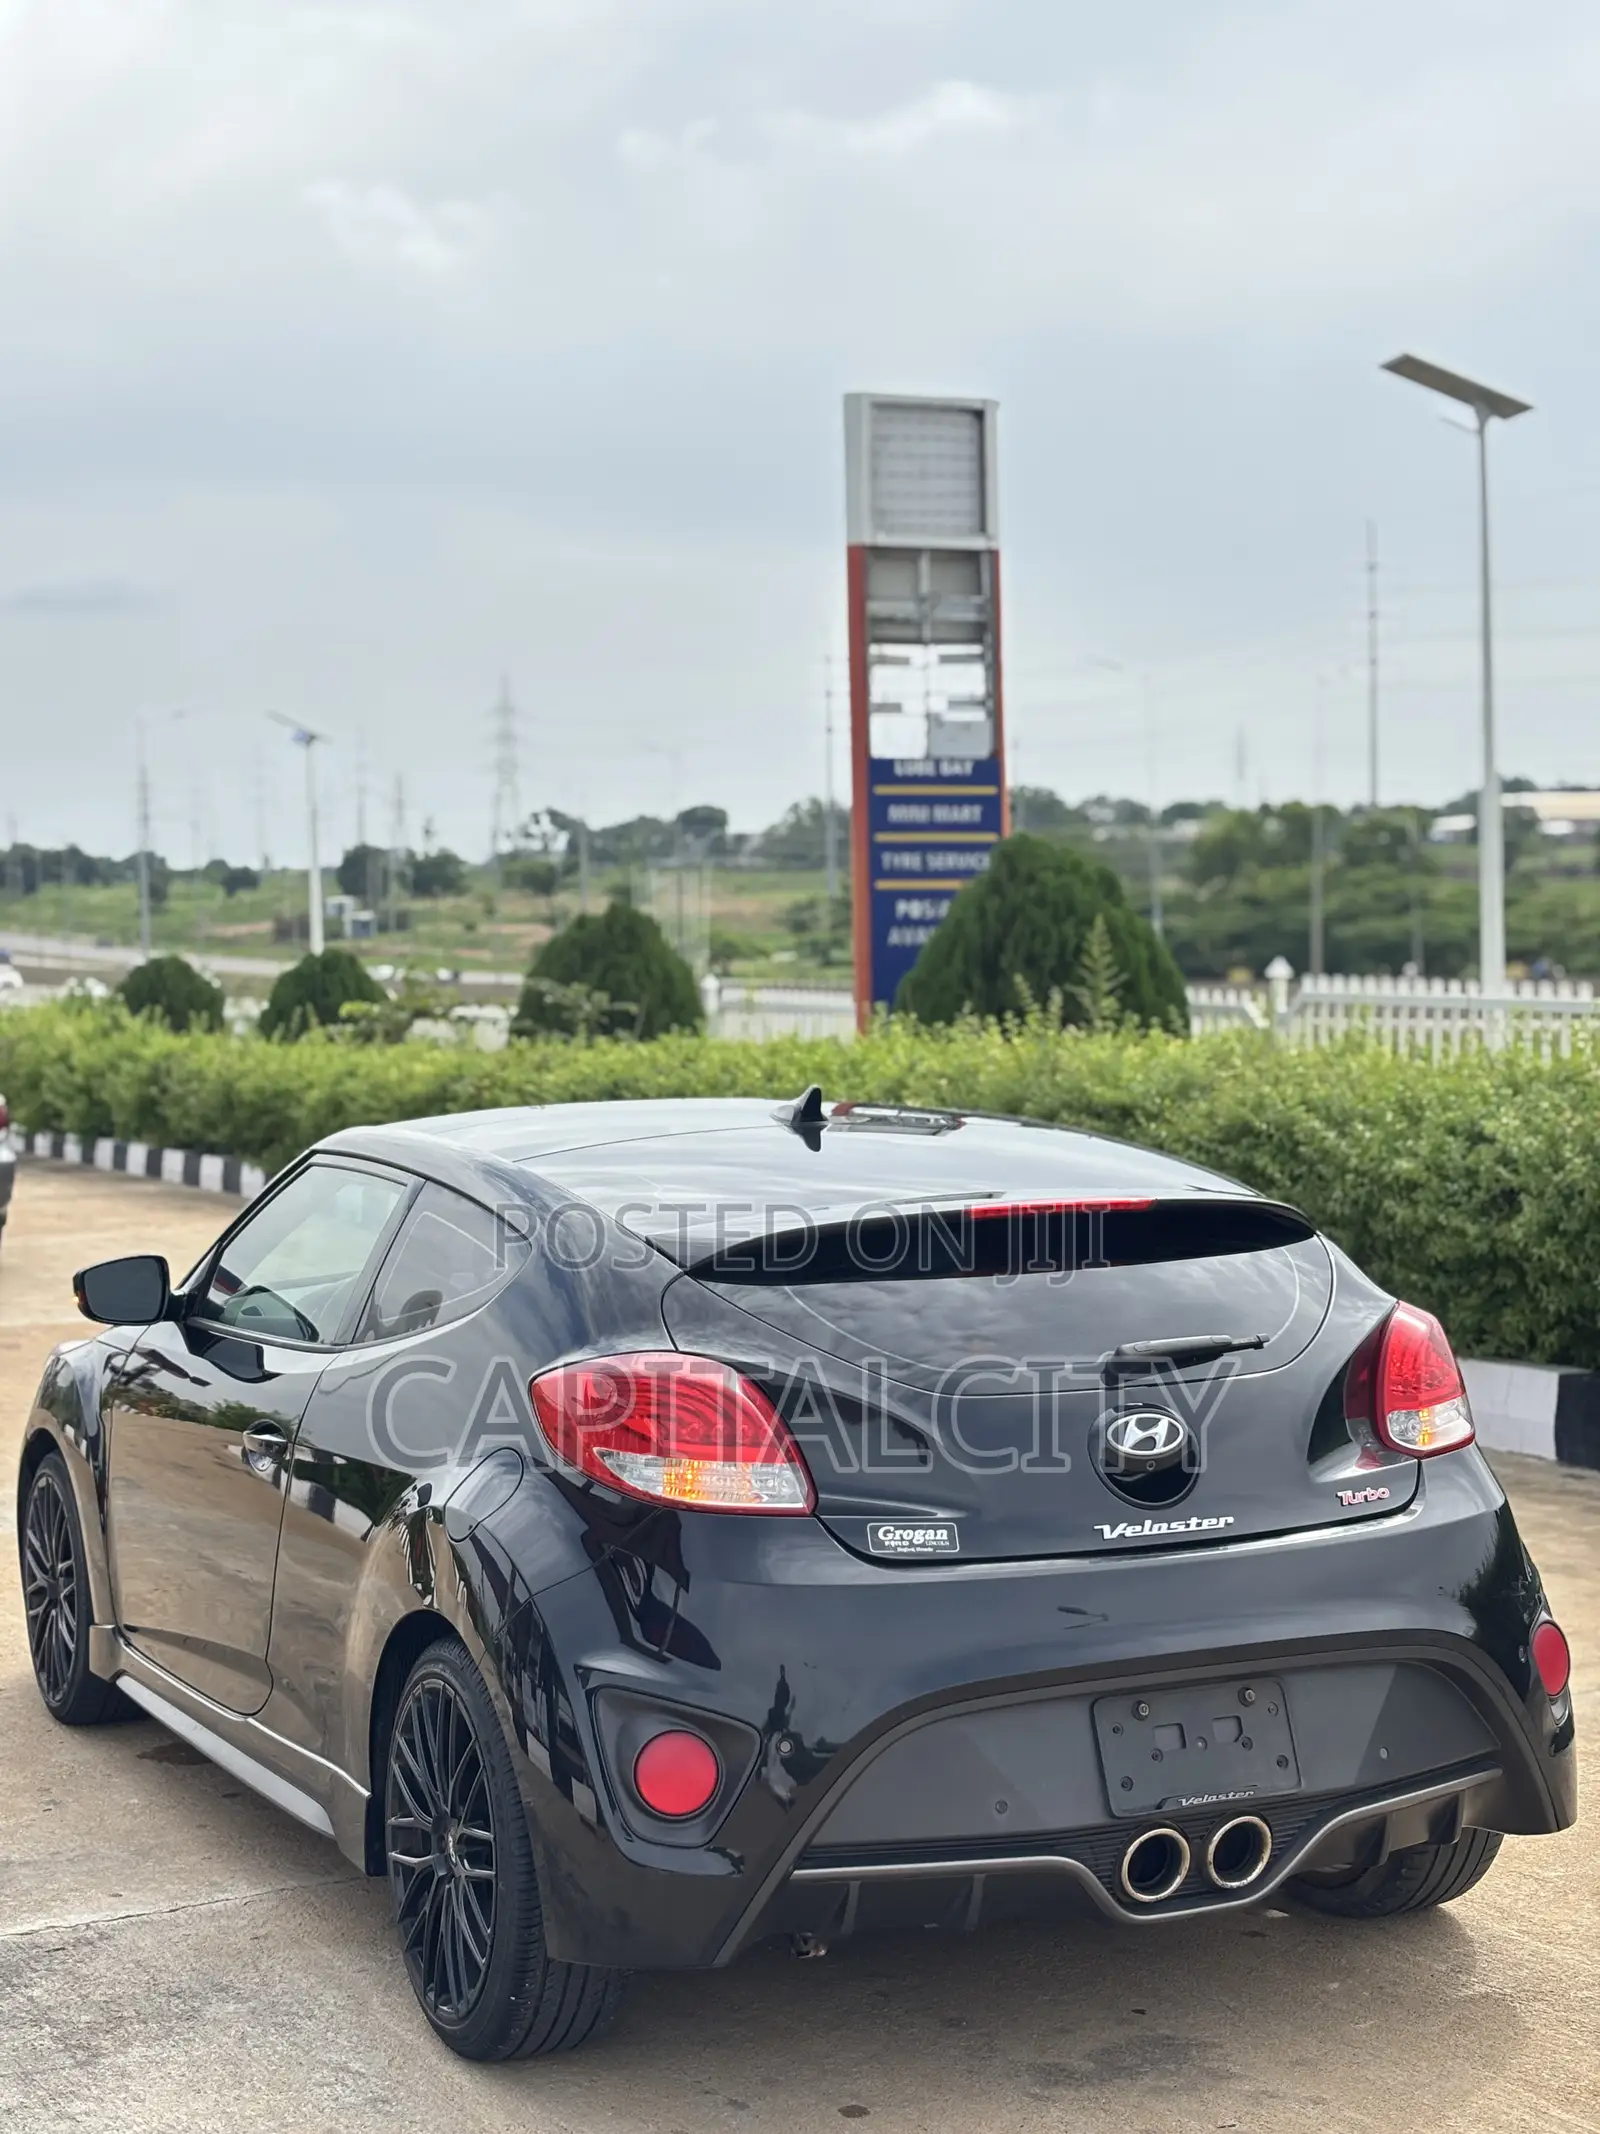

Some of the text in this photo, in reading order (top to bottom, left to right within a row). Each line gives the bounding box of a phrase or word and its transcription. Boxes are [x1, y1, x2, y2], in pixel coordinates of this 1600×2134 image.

[932, 803, 983, 824] MART
[880, 851, 923, 872] TYRE
[1336, 1486, 1390, 1506] Turbo
[878, 1526, 948, 1544] Grogan
